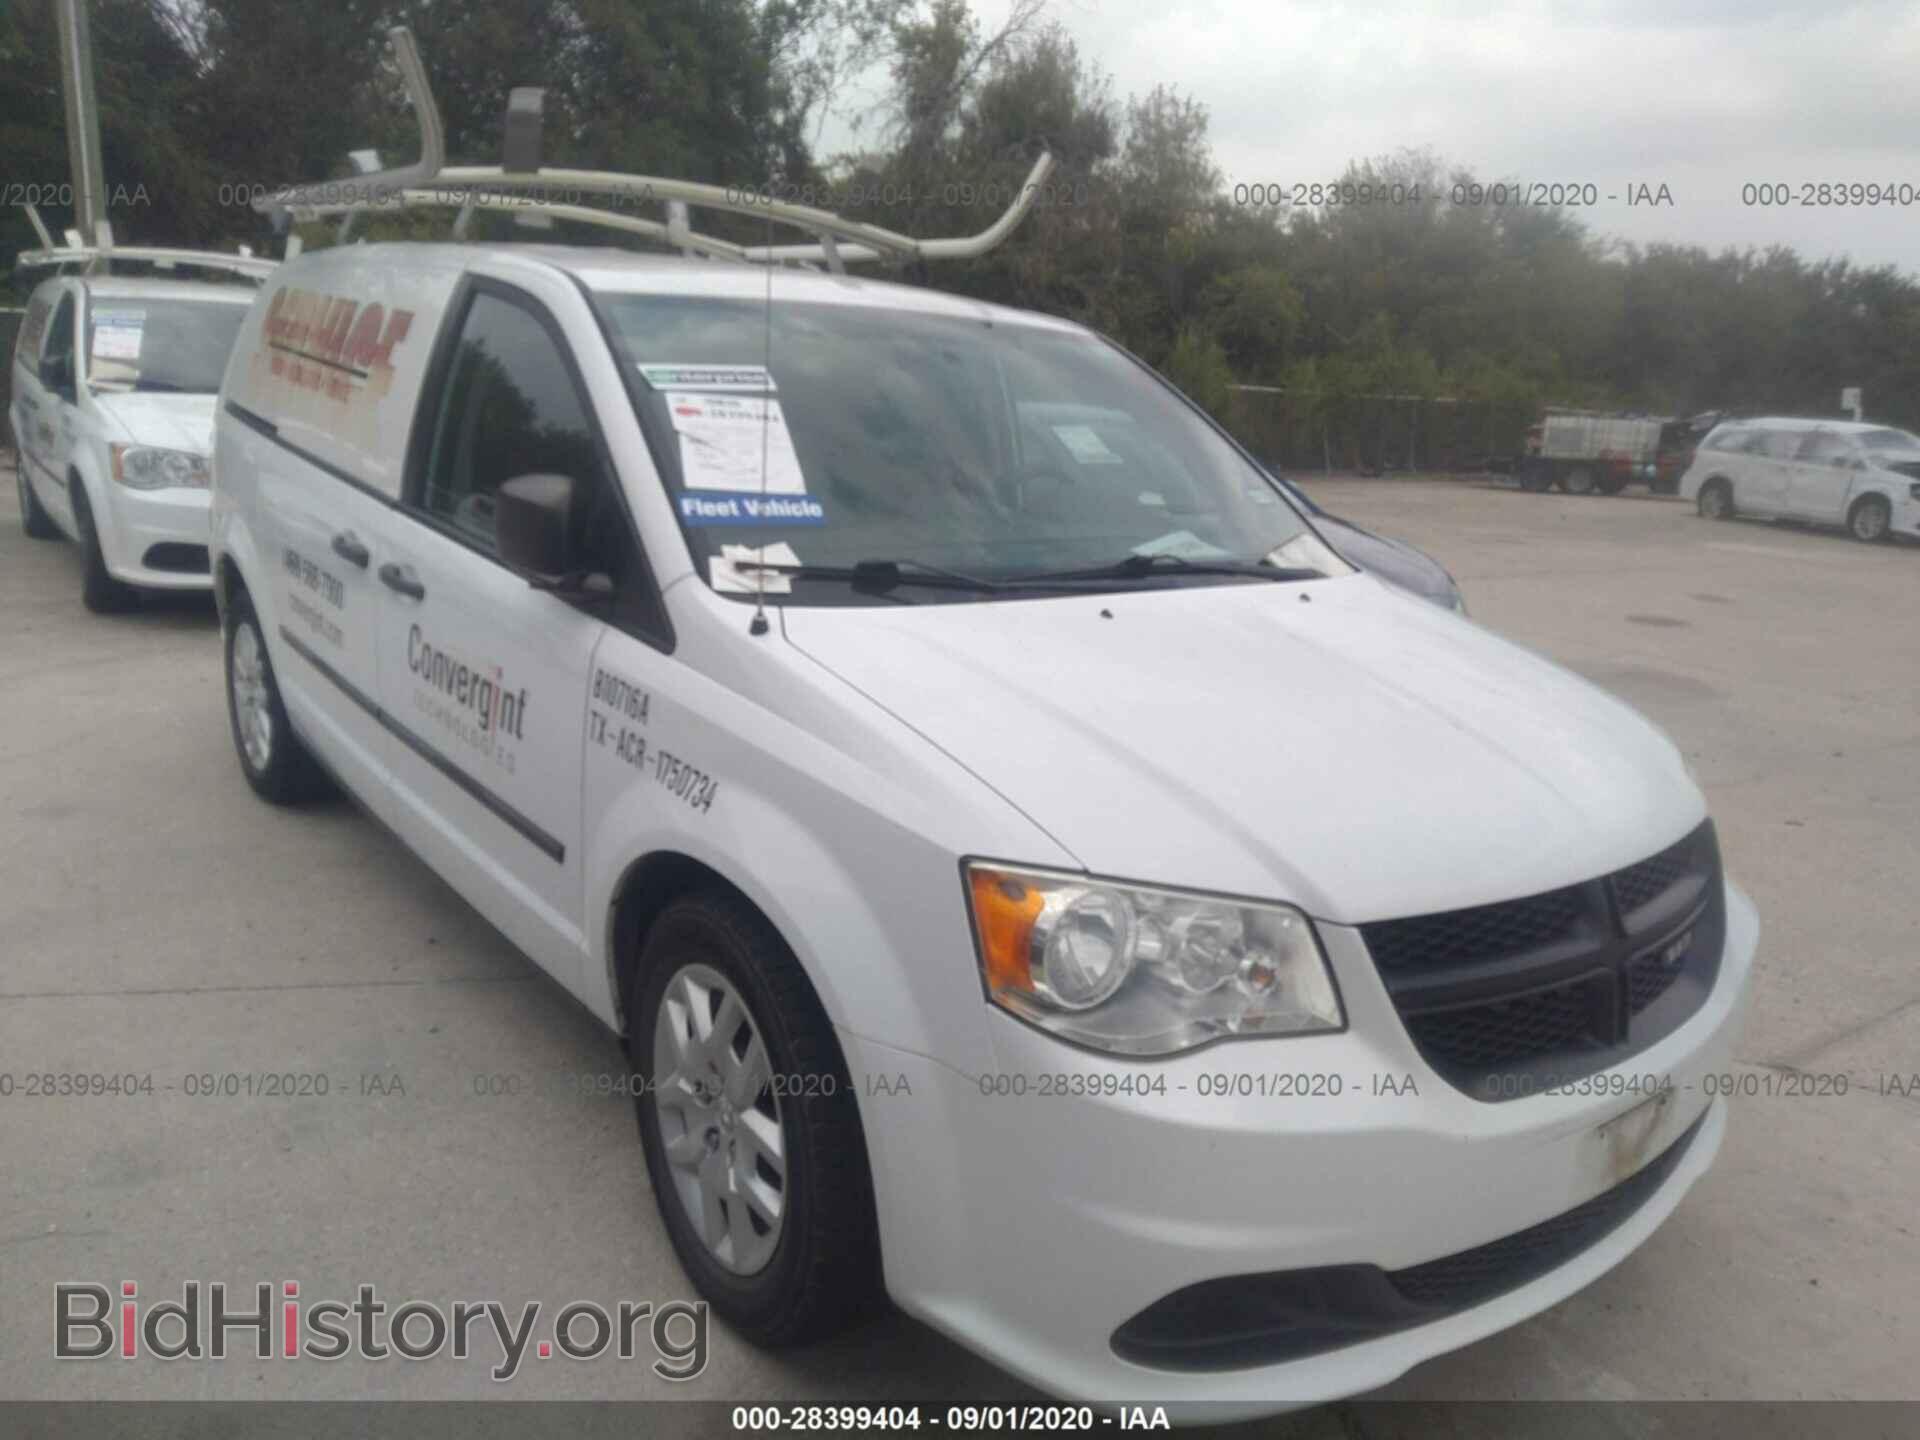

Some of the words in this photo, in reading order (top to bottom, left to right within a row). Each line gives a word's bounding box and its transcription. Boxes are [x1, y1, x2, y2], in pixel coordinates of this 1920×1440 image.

[681, 498, 740, 518] Fleet
[743, 498, 823, 518] Vehicle
[407, 622, 527, 740] Convergint
